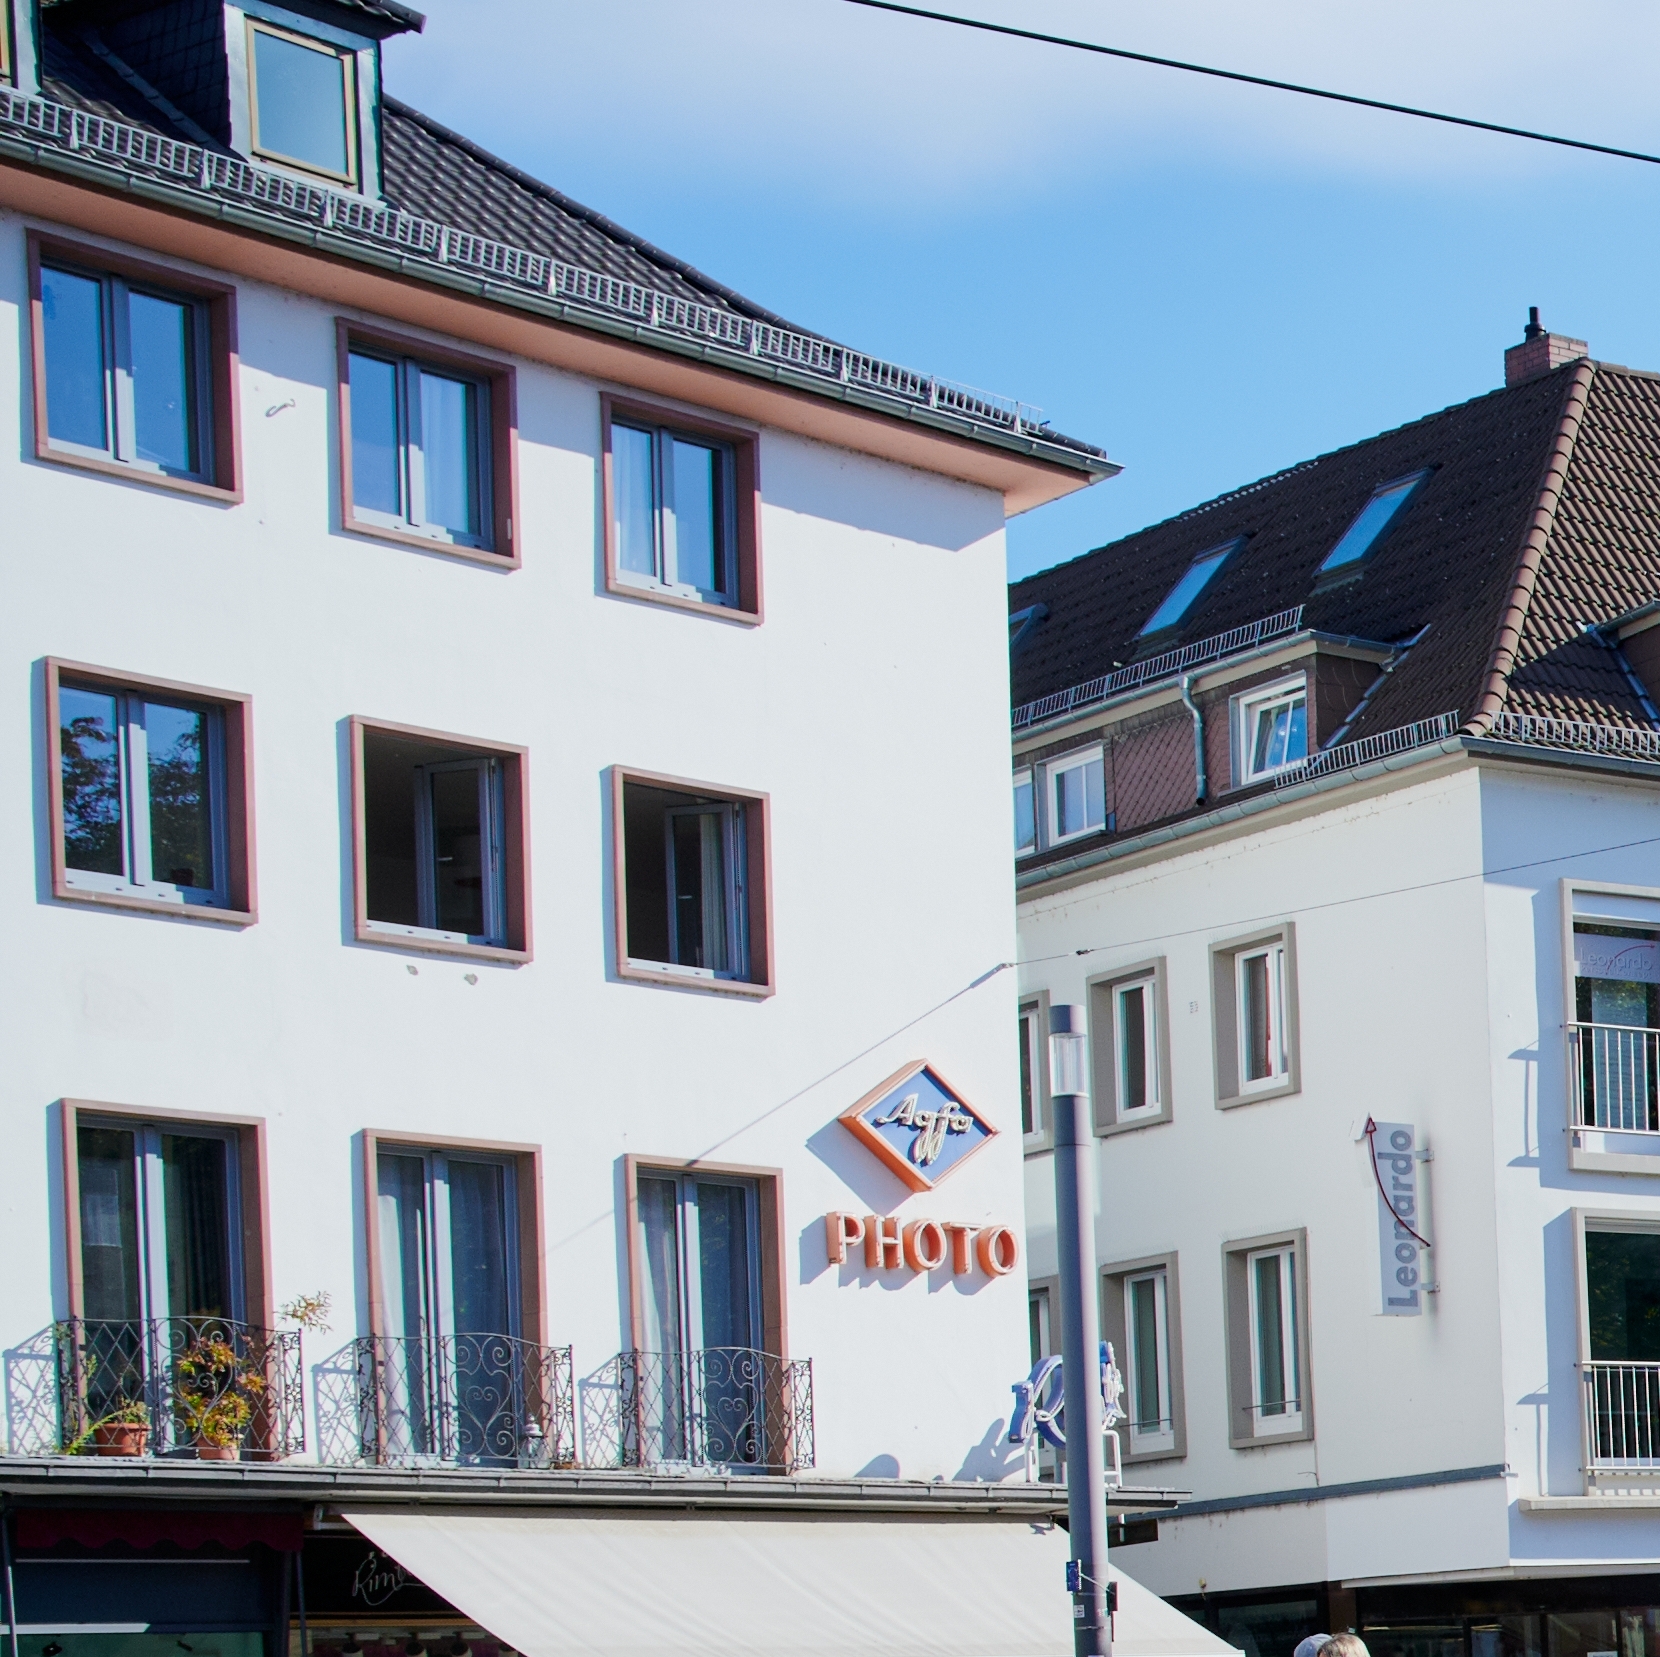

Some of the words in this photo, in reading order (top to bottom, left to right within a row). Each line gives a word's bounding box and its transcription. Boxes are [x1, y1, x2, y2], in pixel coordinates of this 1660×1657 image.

[875, 1093, 974, 1166] Agfa
[826, 1211, 1020, 1279] PHOTO
[1377, 1129, 1419, 1307] Leonardo
